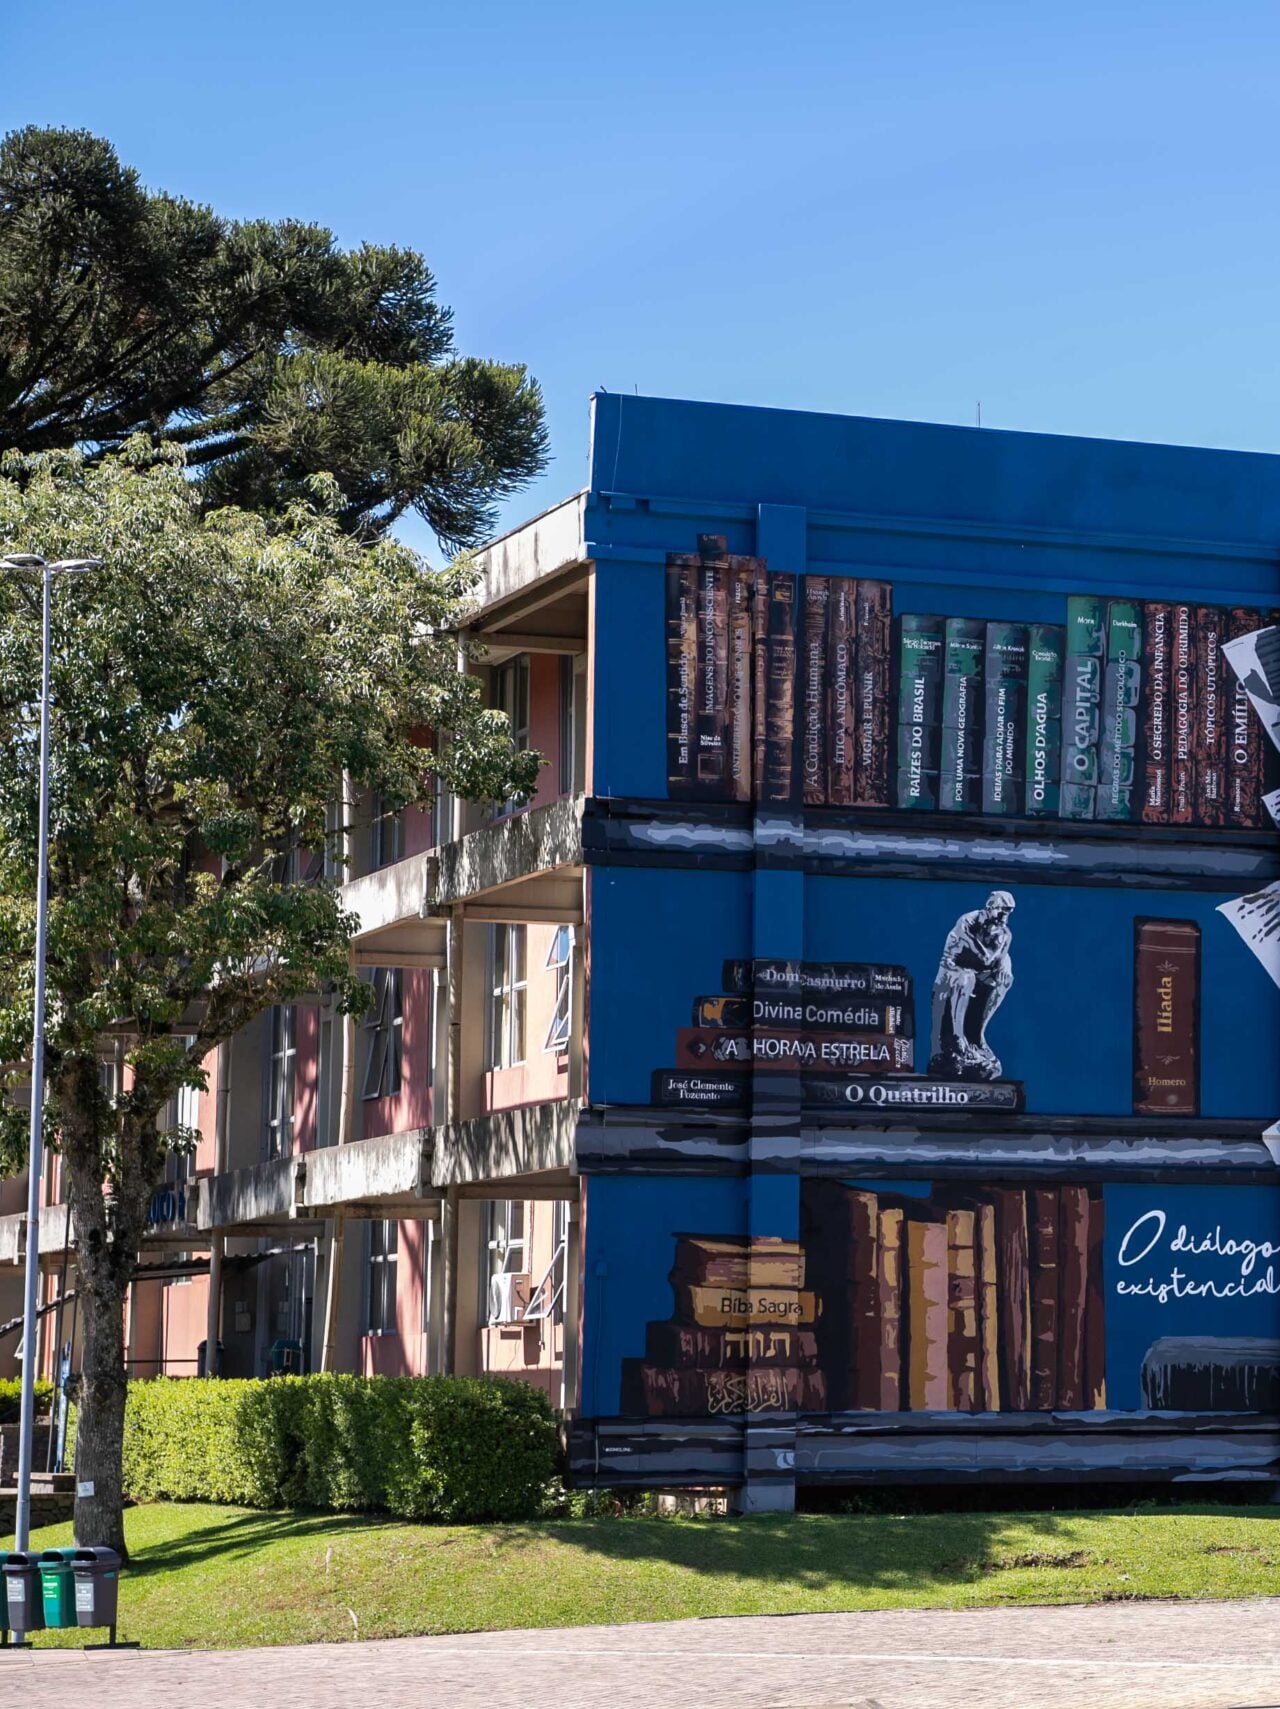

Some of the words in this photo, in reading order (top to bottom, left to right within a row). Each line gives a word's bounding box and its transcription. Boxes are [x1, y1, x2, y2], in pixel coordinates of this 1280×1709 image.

[705, 570, 715, 646] INCONSCIENTE
[1179, 607, 1189, 668] OPRIMIDO
[705, 648, 714, 664] DO
[1206, 632, 1217, 691] UTÓPICOS
[679, 654, 689, 695] Sentido
[806, 643, 819, 703] Humana
[835, 644, 847, 713] NICÔMACO
[1116, 650, 1126, 712] SOCIOLÓGICO
[1153, 673, 1163, 690] DA
[1178, 671, 1188, 691] DO
[679, 697, 688, 710] de
[705, 665, 714, 713] IMAGENS
[863, 672, 873, 708] PUNIR
[912, 677, 925, 723] BRASIL
[958, 677, 968, 729] GEOGRAFIA
[998, 688, 1006, 705] FIM
[863, 711, 873, 720] E
[997, 706, 1006, 714] O
[1075, 661, 1092, 749] CAPITAL
[1153, 692, 1163, 748] SEGREDO
[1205, 693, 1216, 745] TÓPICOS
[679, 713, 688, 744] Busca
[837, 716, 845, 726] A
[996, 716, 1005, 744] ADIAR
[1113, 713, 1123, 753] MÉTODO
[1178, 694, 1188, 759] PEDAGOGIA
[806, 707, 821, 772] Condição
[834, 728, 845, 764] ÉTICA
[862, 722, 873, 765] VIGIAR
[912, 726, 923, 747] DO
[957, 731, 965, 757] NOVA
[1006, 722, 1014, 759] MUNDO
[679, 747, 688, 764] Em
[956, 758, 964, 780] UMA
[996, 745, 1004, 769] PARA
[1005, 760, 1013, 774] DO
[1073, 754, 1089, 771] O
[1113, 754, 1121, 768] DO
[1152, 750, 1162, 760] O
[1234, 749, 1248, 763] O
[806, 775, 818, 787] A
[908, 751, 922, 797] RAÍZES
[994, 771, 1002, 801] IDEIAS
[1034, 750, 1046, 800] OLHOS
[1111, 769, 1120, 804] REGRAS
[766, 968, 800, 982] Dom
[753, 1001, 802, 1019] Divina
[805, 1005, 879, 1025] Comédia
[1156, 975, 1173, 1033] Ilíada
[726, 1039, 738, 1056] A
[753, 1038, 802, 1056] HORA
[821, 1043, 891, 1061] ESTRELA
[667, 1079, 688, 1090] José
[690, 1079, 735, 1091] Clemente
[845, 1084, 864, 1102] O
[869, 1085, 969, 1106] Quatrilho
[1148, 1076, 1186, 1087] Homero
[1118, 1209, 1166, 1266] O
[1170, 1224, 1280, 1276] diálogo
